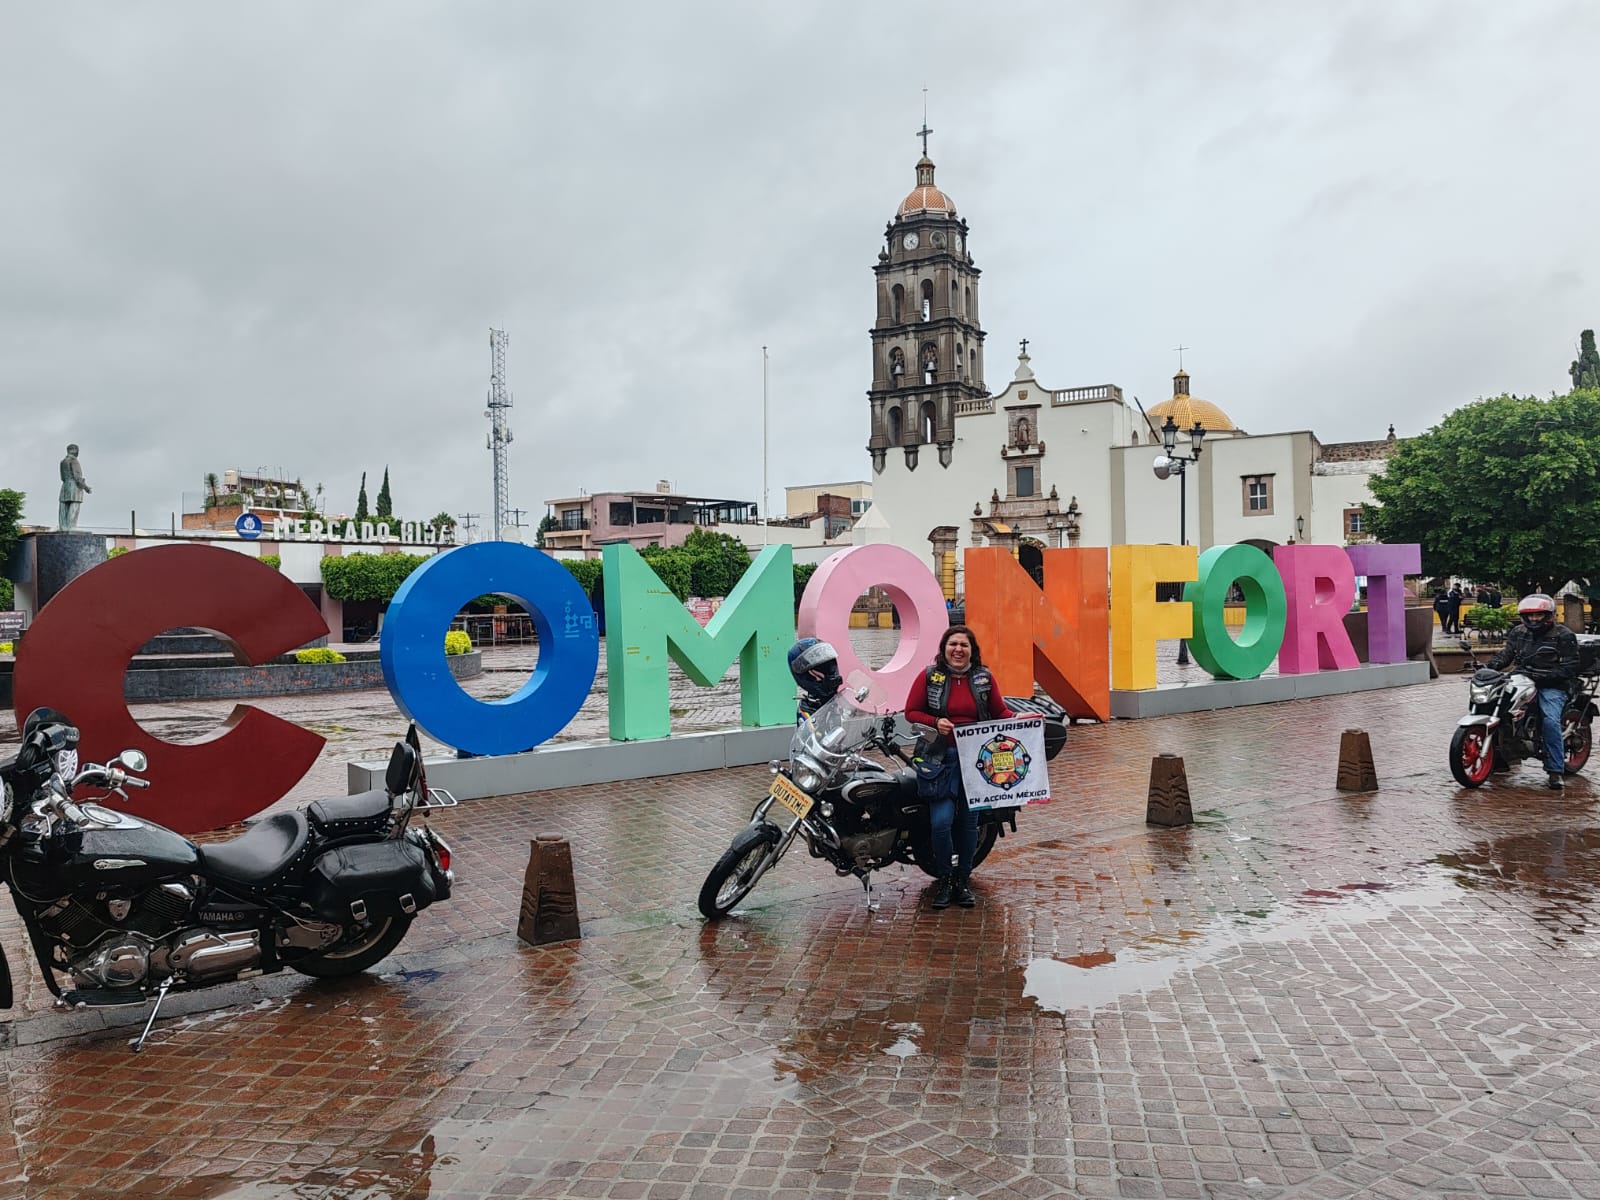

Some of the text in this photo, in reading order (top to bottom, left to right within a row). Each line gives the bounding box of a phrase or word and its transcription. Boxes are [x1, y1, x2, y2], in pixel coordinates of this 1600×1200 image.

[273, 516, 390, 543] MERCADO
[14, 541, 1422, 833] COMONFORT
[956, 720, 1041, 738] MOTOTURISMO
[773, 783, 806, 815] OUTATIME
[969, 797, 980, 805] EN
[983, 792, 1014, 803] ACCIÓN
[1016, 789, 1047, 799] MÉXICO
[198, 911, 235, 921] YAMAHA
